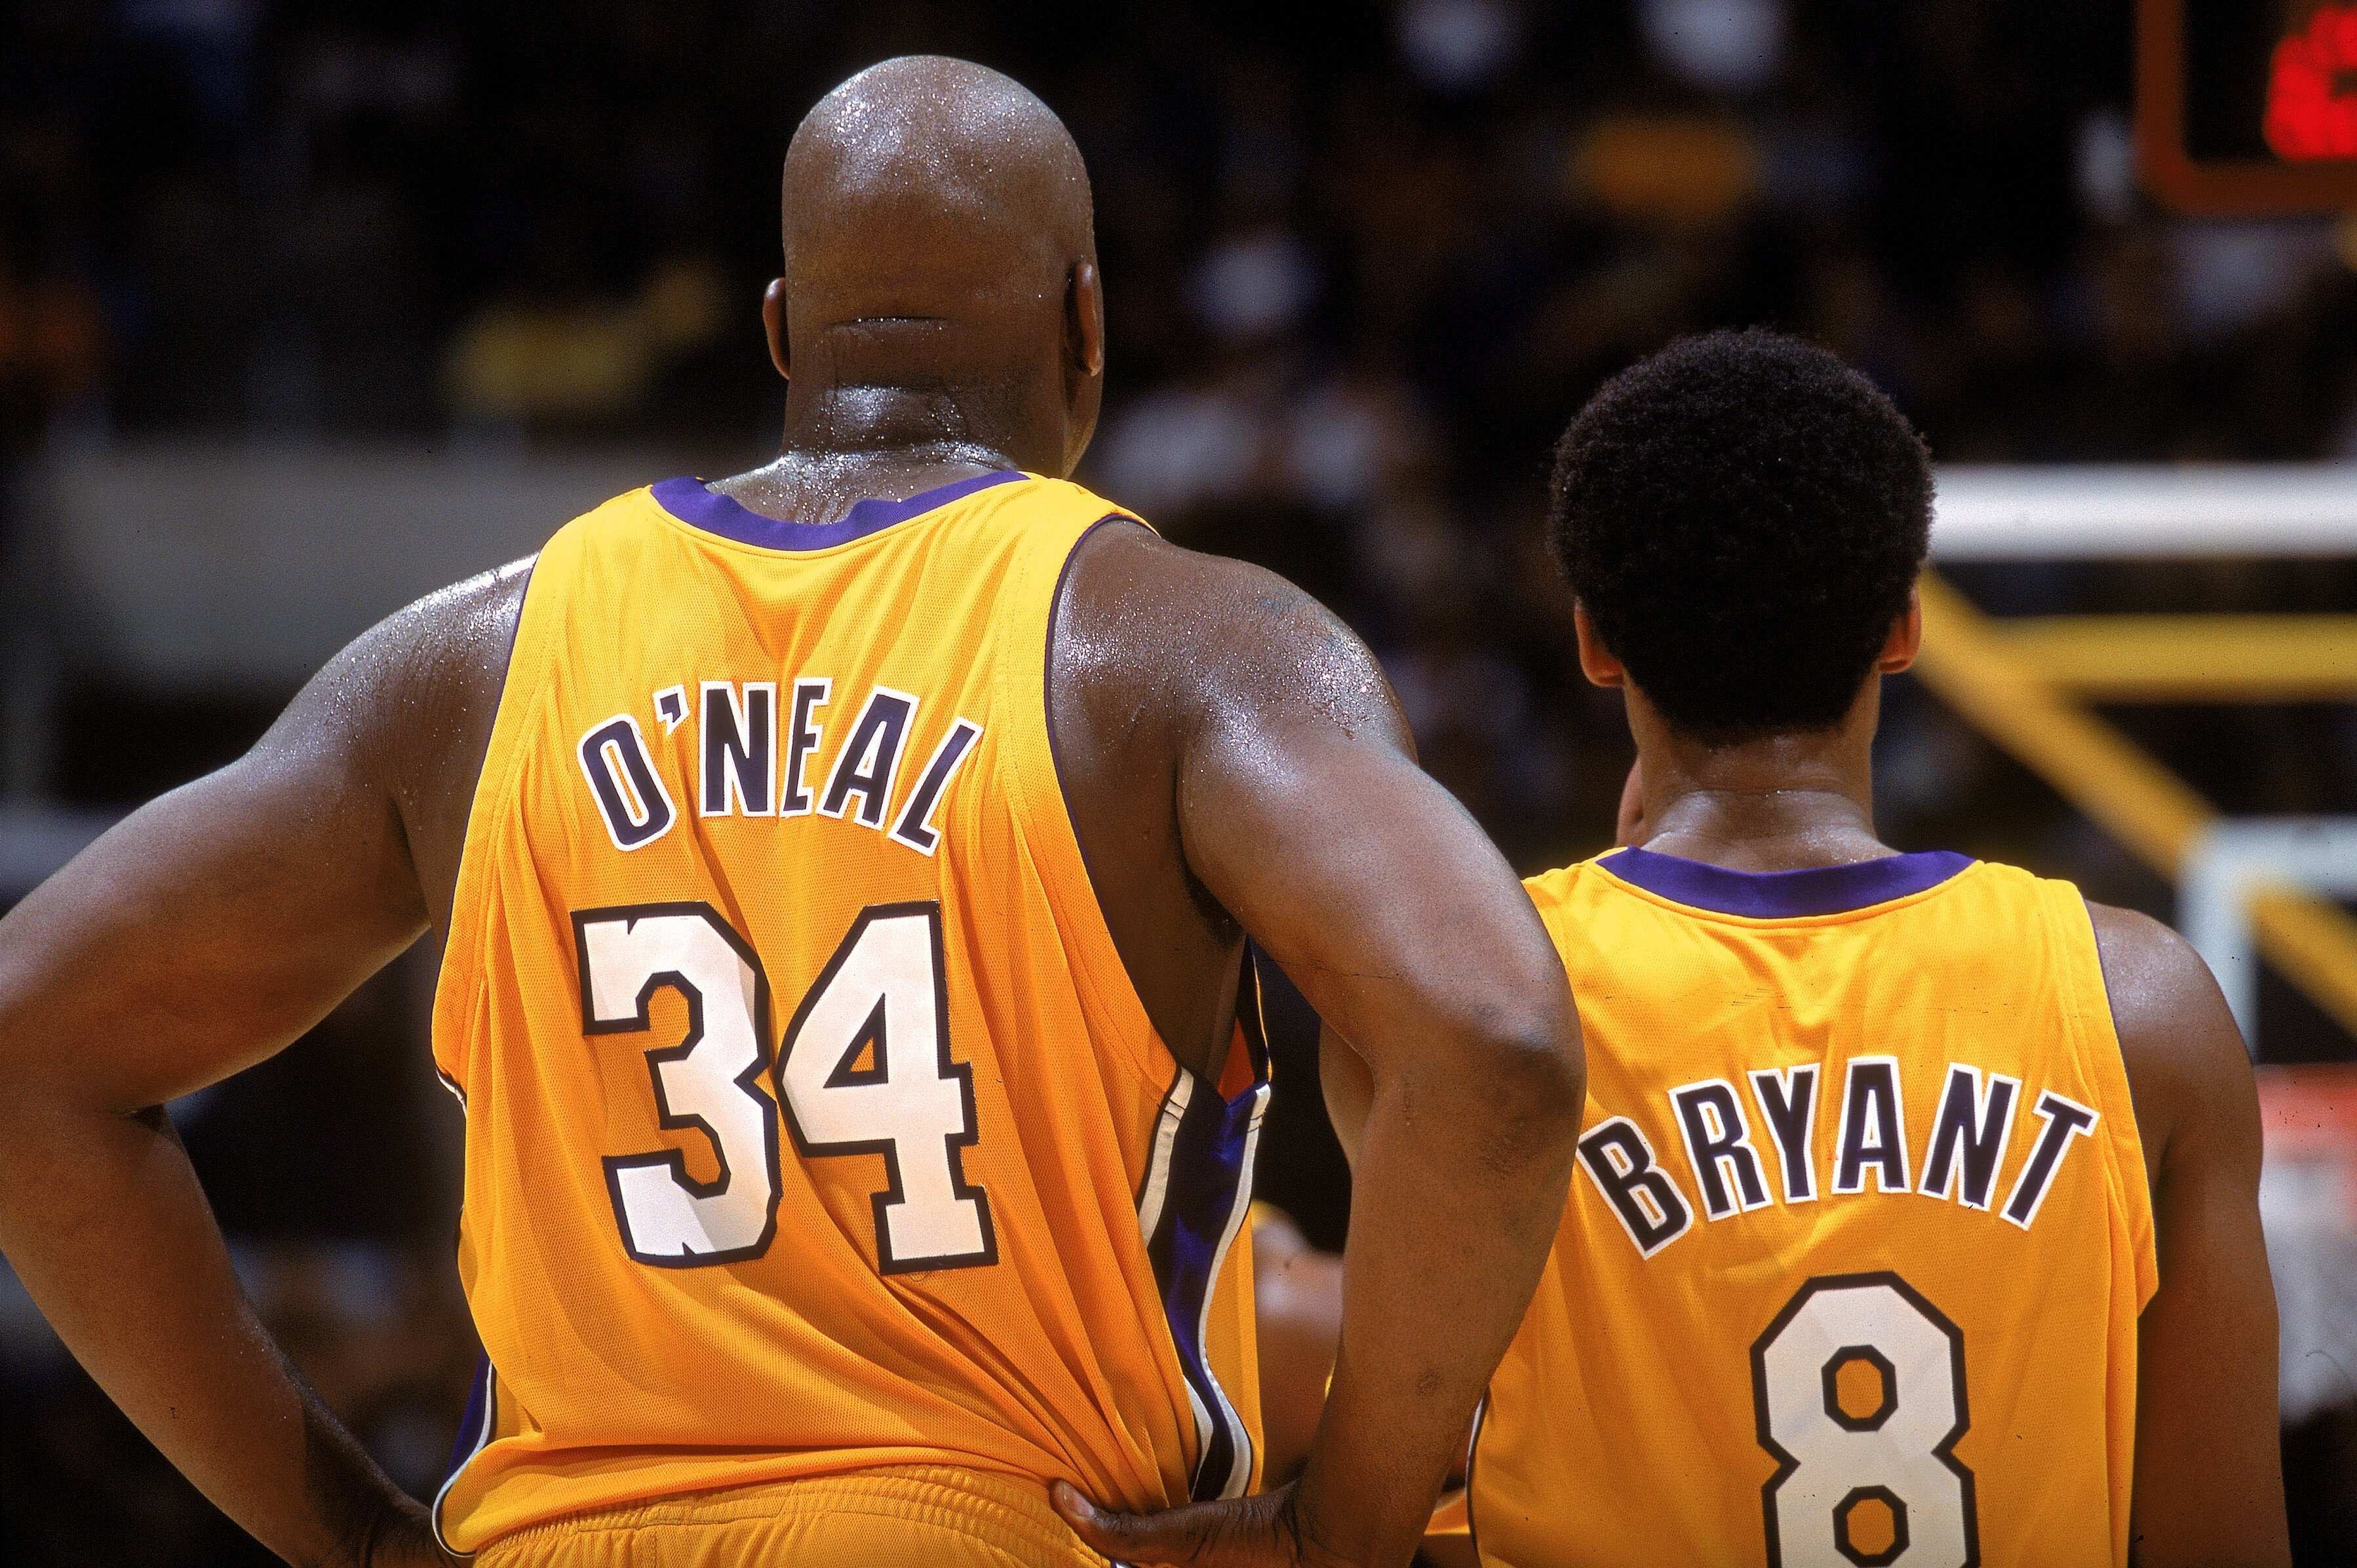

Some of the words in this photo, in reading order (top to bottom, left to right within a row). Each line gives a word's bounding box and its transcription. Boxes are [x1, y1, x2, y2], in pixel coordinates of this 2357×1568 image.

[577, 678, 984, 856] O'NEAL
[570, 900, 998, 1276] 34
[1576, 1056, 2100, 1260] BRYANT
[1749, 1271, 1981, 1568] 8
